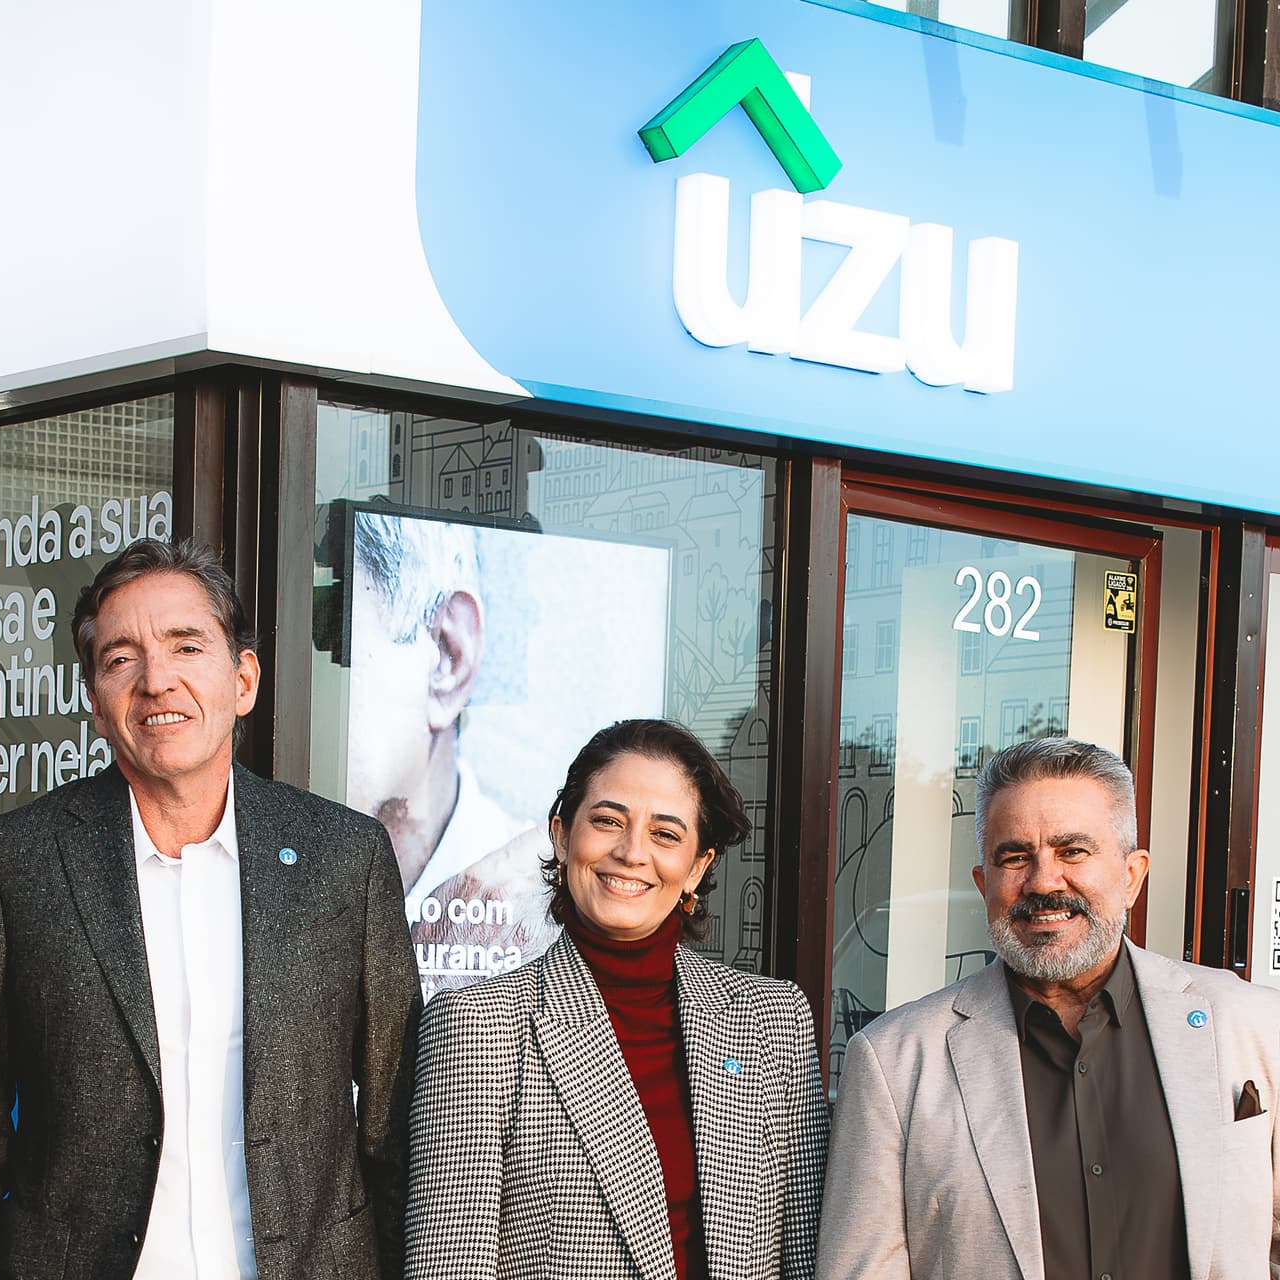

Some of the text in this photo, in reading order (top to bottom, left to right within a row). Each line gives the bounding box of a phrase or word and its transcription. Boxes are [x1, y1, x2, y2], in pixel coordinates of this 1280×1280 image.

[674, 172, 1019, 394] uzu
[69, 504, 92, 558] a
[100, 491, 173, 554] sua
[32, 587, 56, 640] e
[952, 566, 1042, 641] 282
[31, 720, 111, 792] nela
[448, 898, 513, 924] com
[414, 944, 521, 977] urança
